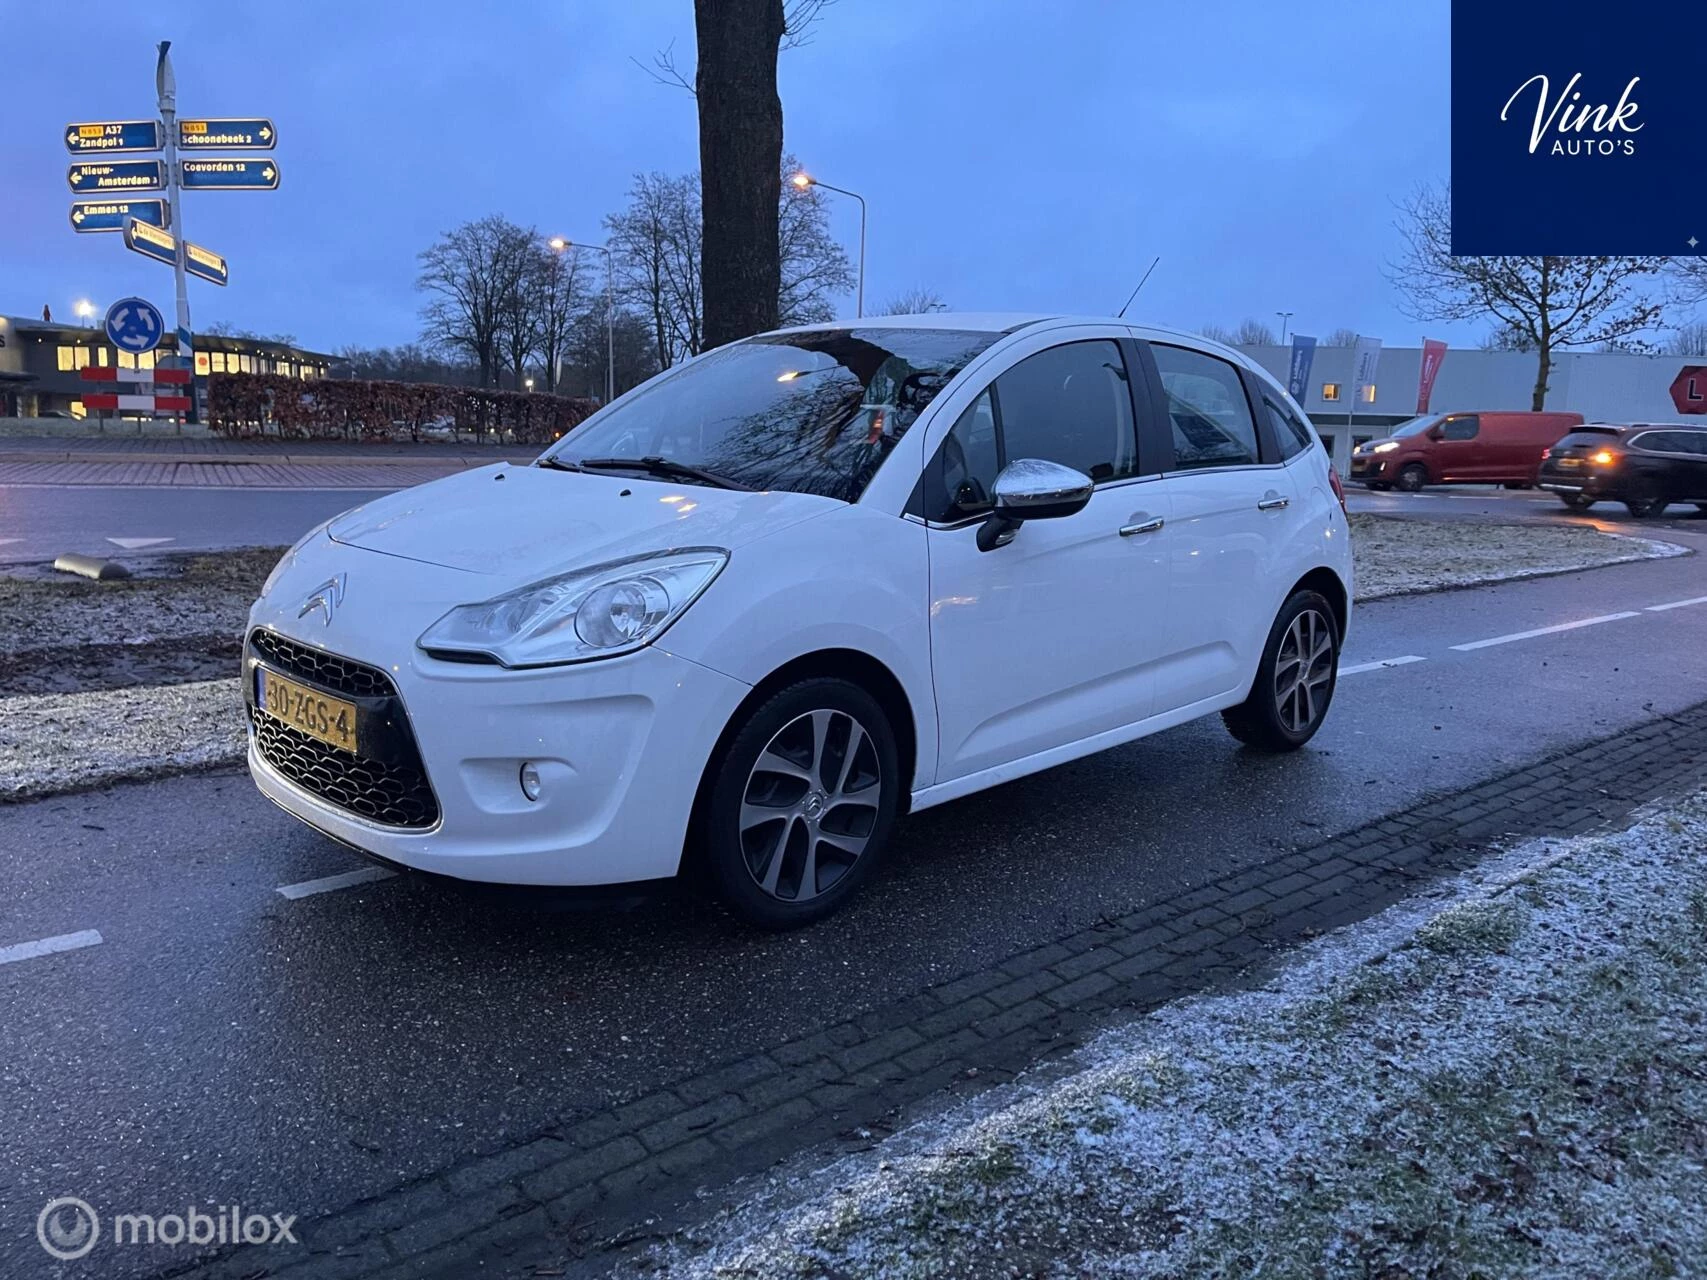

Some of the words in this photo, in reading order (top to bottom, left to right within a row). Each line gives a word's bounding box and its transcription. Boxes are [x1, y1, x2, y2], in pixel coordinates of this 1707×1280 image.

[105, 125, 122, 135] A37
[79, 138, 117, 148] Zandpol
[182, 134, 244, 144] Schoonebeek
[81, 165, 114, 175] Nieuw-
[183, 162, 234, 171] Coevorden
[97, 175, 151, 187] Amsterdam
[83, 205, 118, 215] Emmen
[118, 205, 129, 213] 12
[267, 678, 350, 742] 30-ZGS-4
